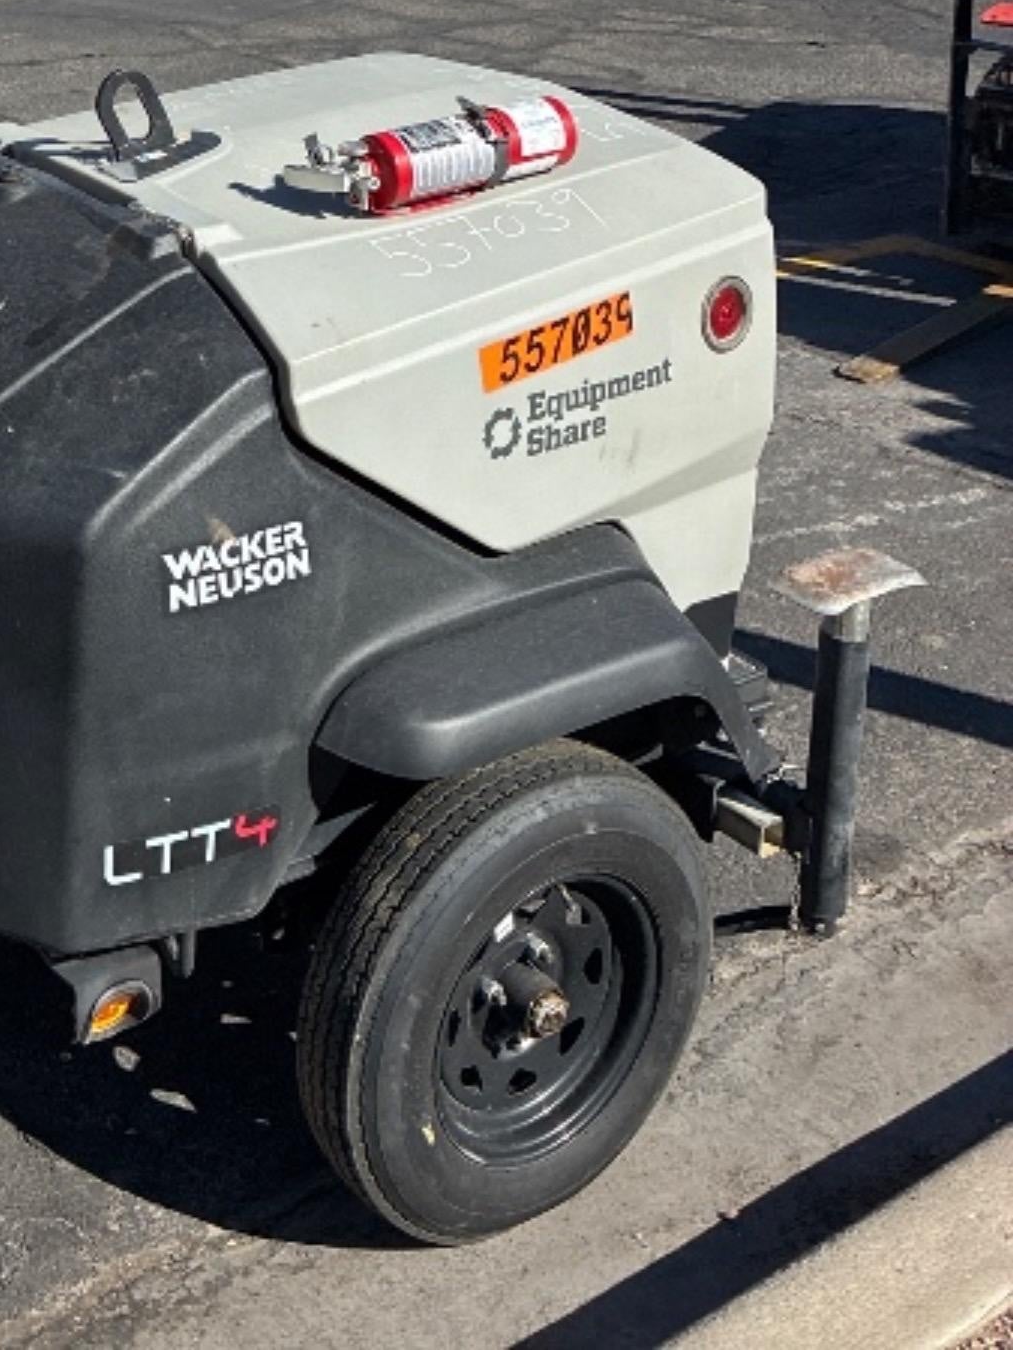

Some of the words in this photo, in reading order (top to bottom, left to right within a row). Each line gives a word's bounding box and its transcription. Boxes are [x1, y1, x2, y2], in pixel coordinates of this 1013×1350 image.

[370, 188, 610, 278] 557039
[499, 291, 634, 384] 557039
[526, 358, 672, 422] Equipment
[526, 416, 607, 457] Share
[162, 521, 308, 581] WACKER
[168, 548, 311, 613] NEUSON
[103, 813, 278, 886] LTT4
